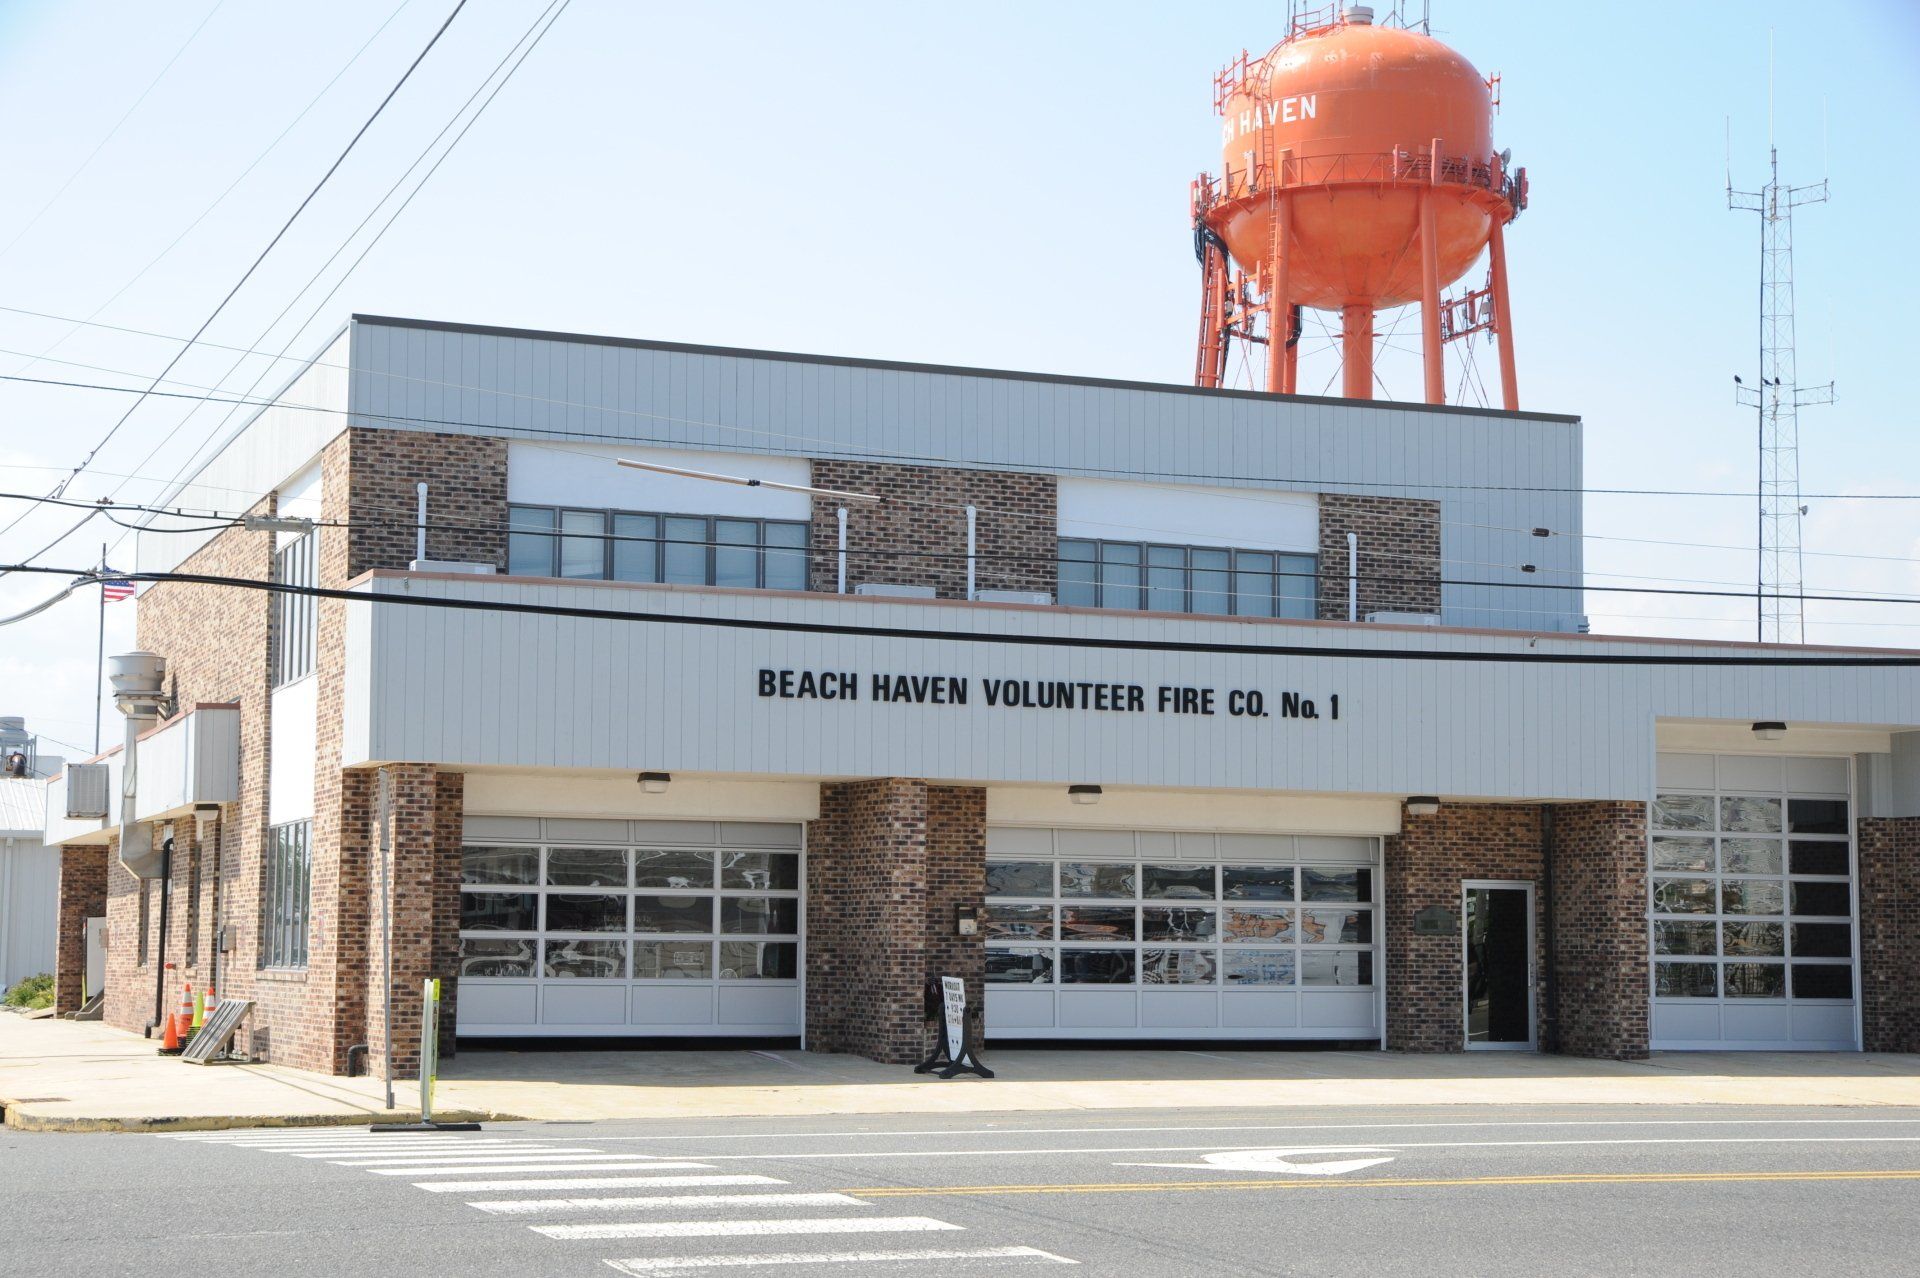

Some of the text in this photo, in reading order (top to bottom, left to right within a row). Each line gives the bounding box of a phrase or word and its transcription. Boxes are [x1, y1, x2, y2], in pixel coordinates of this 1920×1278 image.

[1239, 95, 1316, 136] HAVEN
[758, 669, 1339, 720] BEACH HAVEN VOLUNTEER FIRE CO. No. 1
